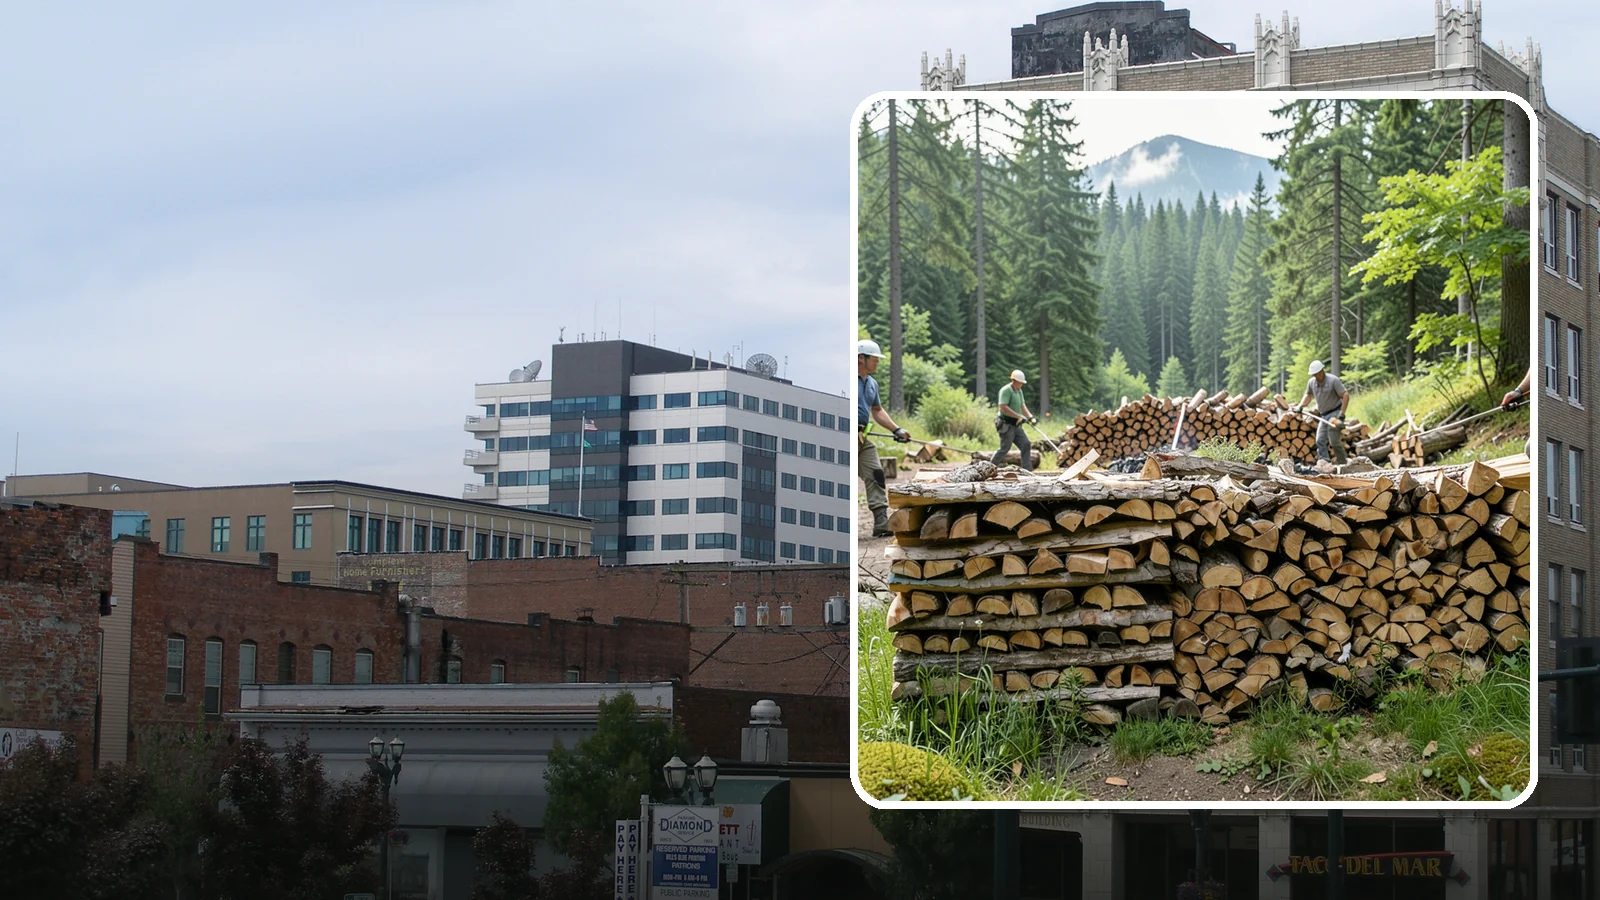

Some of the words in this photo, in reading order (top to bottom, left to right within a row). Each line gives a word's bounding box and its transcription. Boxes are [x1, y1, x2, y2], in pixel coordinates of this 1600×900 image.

[370, 566, 427, 577] Furnishers
[660, 818, 713, 833] DIAMOND
[1022, 815, 1070, 827] BUILDING
[617, 825, 625, 852] PAY
[628, 825, 637, 852] PAY
[655, 845, 687, 853] RESERVED
[671, 862, 701, 870] PATRONS
[1346, 856, 1385, 875] DEL
[1392, 857, 1442, 877] MAR
[616, 856, 625, 894] HERE
[628, 856, 636, 893] HERE
[660, 888, 682, 897] PUBLIC
[683, 890, 710, 898] PARKING
